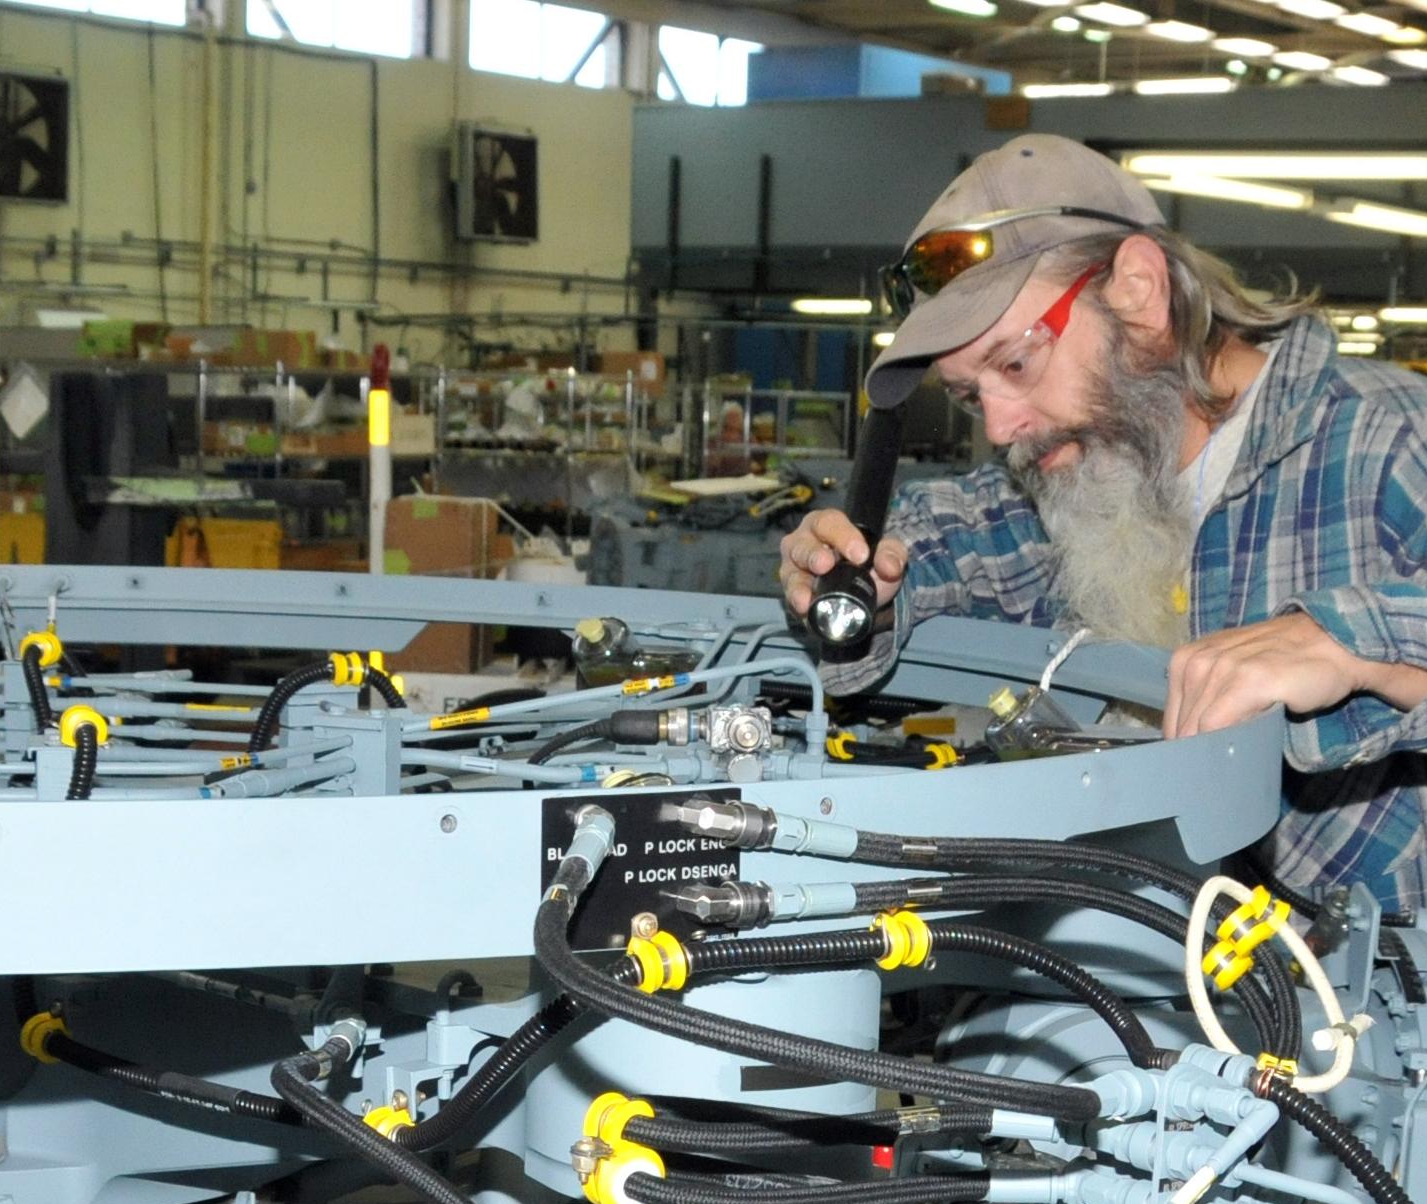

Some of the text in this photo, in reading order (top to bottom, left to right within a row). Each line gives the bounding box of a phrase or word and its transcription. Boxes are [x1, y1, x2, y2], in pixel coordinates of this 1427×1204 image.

[644, 842, 653, 855] P
[659, 839, 695, 854] LOCK
[625, 863, 737, 884] P LOCK DSENGA
